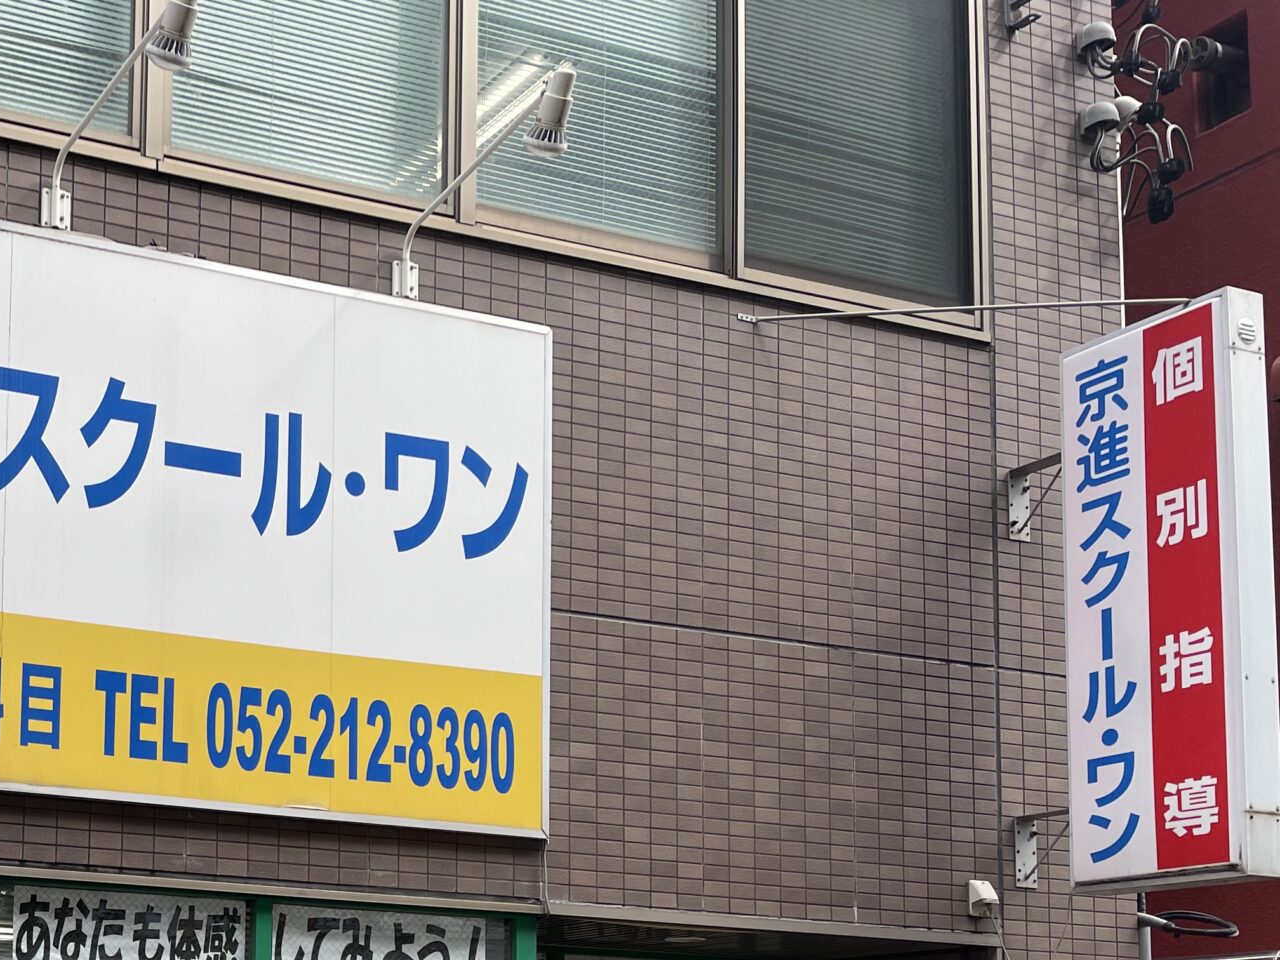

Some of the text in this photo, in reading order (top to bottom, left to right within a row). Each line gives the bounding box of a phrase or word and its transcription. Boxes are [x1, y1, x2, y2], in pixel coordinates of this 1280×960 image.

[95, 669, 189, 765] TEL
[206, 682, 516, 795] 052-212-8390
[1075, 355, 1140, 864] 京進スクール・ワン
[1152, 336, 1220, 839] 個別指導
